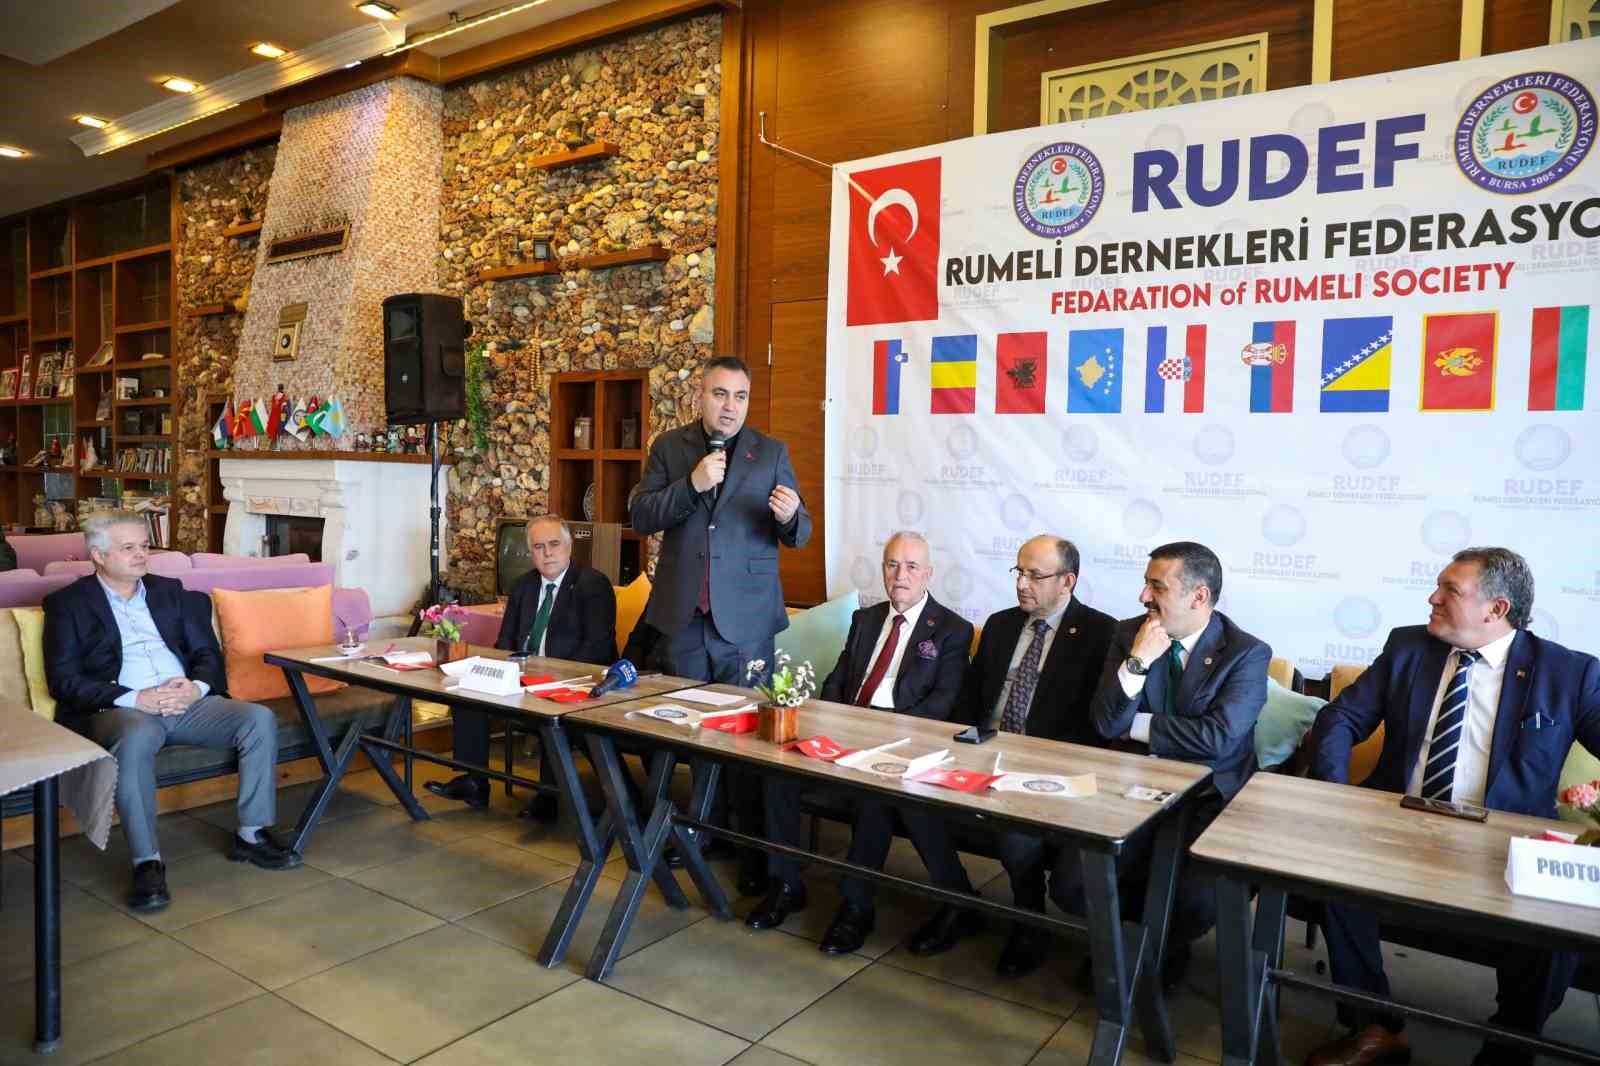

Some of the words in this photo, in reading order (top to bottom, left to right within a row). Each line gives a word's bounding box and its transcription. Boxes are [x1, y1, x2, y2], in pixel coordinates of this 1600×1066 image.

[1553, 77, 1593, 167] FEDERASYONU
[1132, 113, 1426, 213] RUDEF
[1488, 177, 1527, 189] BURSA
[1498, 156, 1546, 170] RUDEF
[946, 239, 1062, 287] RUMELİ
[1074, 217, 1308, 277] DERNEKLERİ
[1051, 282, 1211, 315] FEDARATION
[1219, 281, 1247, 306] of
[1255, 273, 1362, 303] RUMELI
[1372, 261, 1515, 298] SOCIETY
